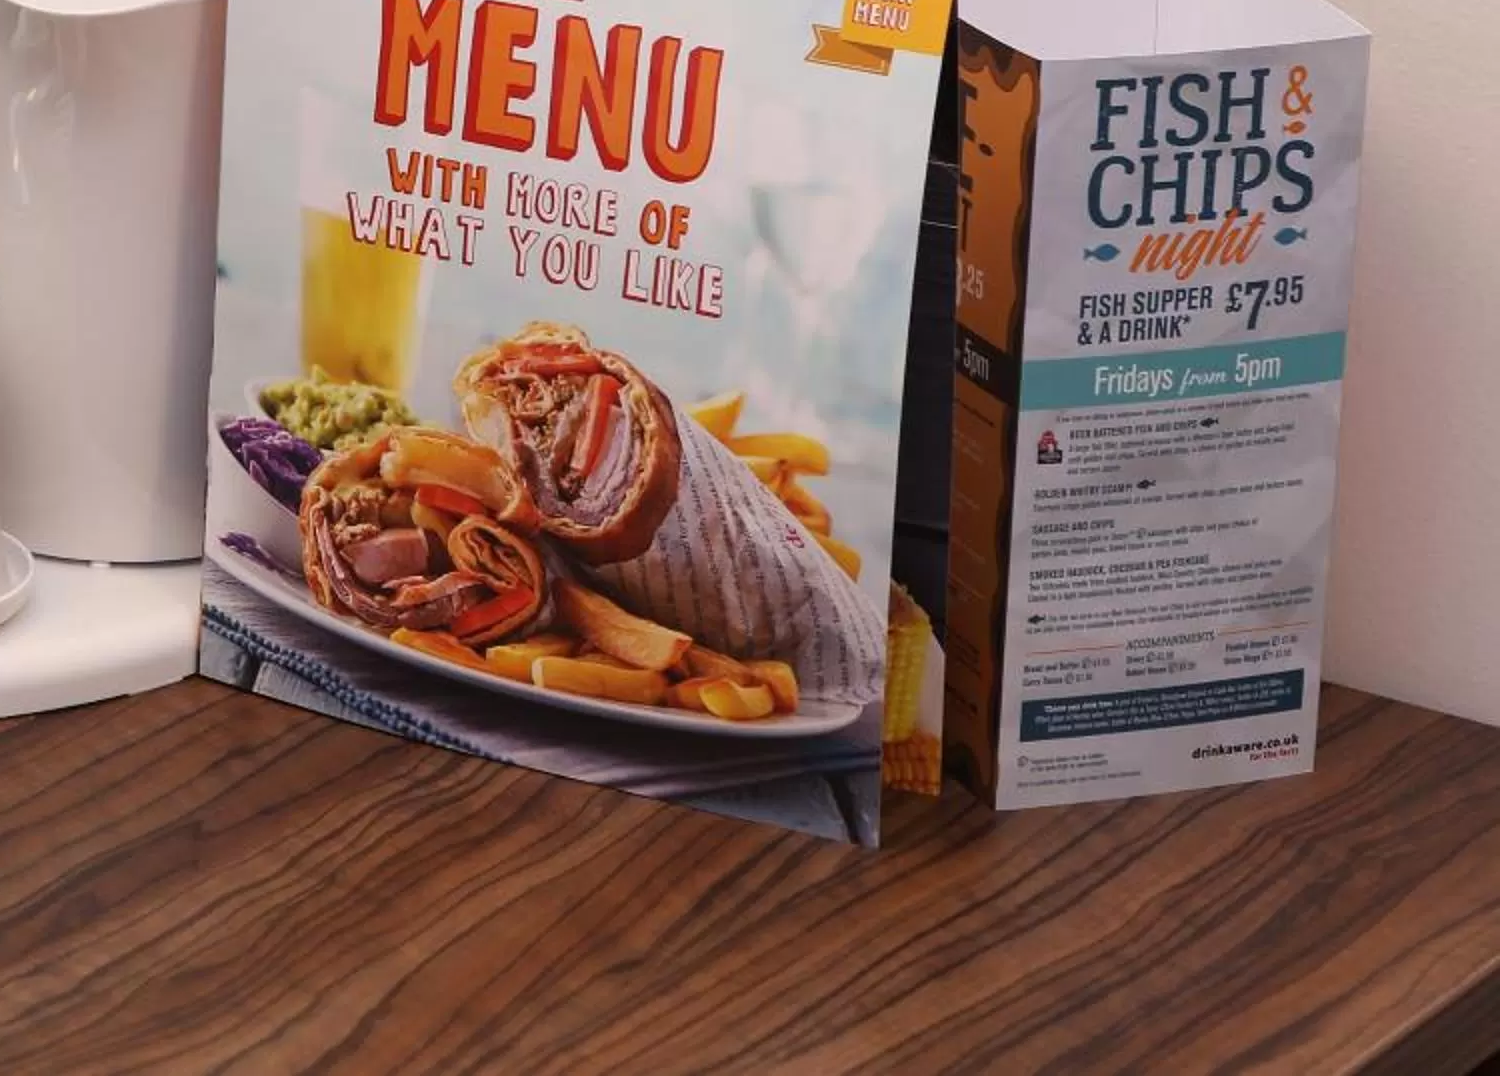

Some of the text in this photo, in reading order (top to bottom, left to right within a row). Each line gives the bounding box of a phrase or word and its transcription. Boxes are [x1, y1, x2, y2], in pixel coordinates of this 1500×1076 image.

[852, 0, 911, 32] MENU
[1090, 64, 1314, 152] FISH &
[386, 147, 691, 251] WITH MORE OF
[1087, 139, 1315, 229] CHIPS
[347, 191, 724, 319] WHAT YOU LIKE
[1129, 208, 1267, 281] night
[1079, 275, 1305, 331] FISH SUPPER £7.95
[962, 338, 990, 383] 5pm
[1078, 322, 1093, 346] &
[1099, 322, 1112, 344] A
[1094, 353, 1282, 398] Fridays from 5pm
[1191, 733, 1300, 760] drinkaware.co.uk
